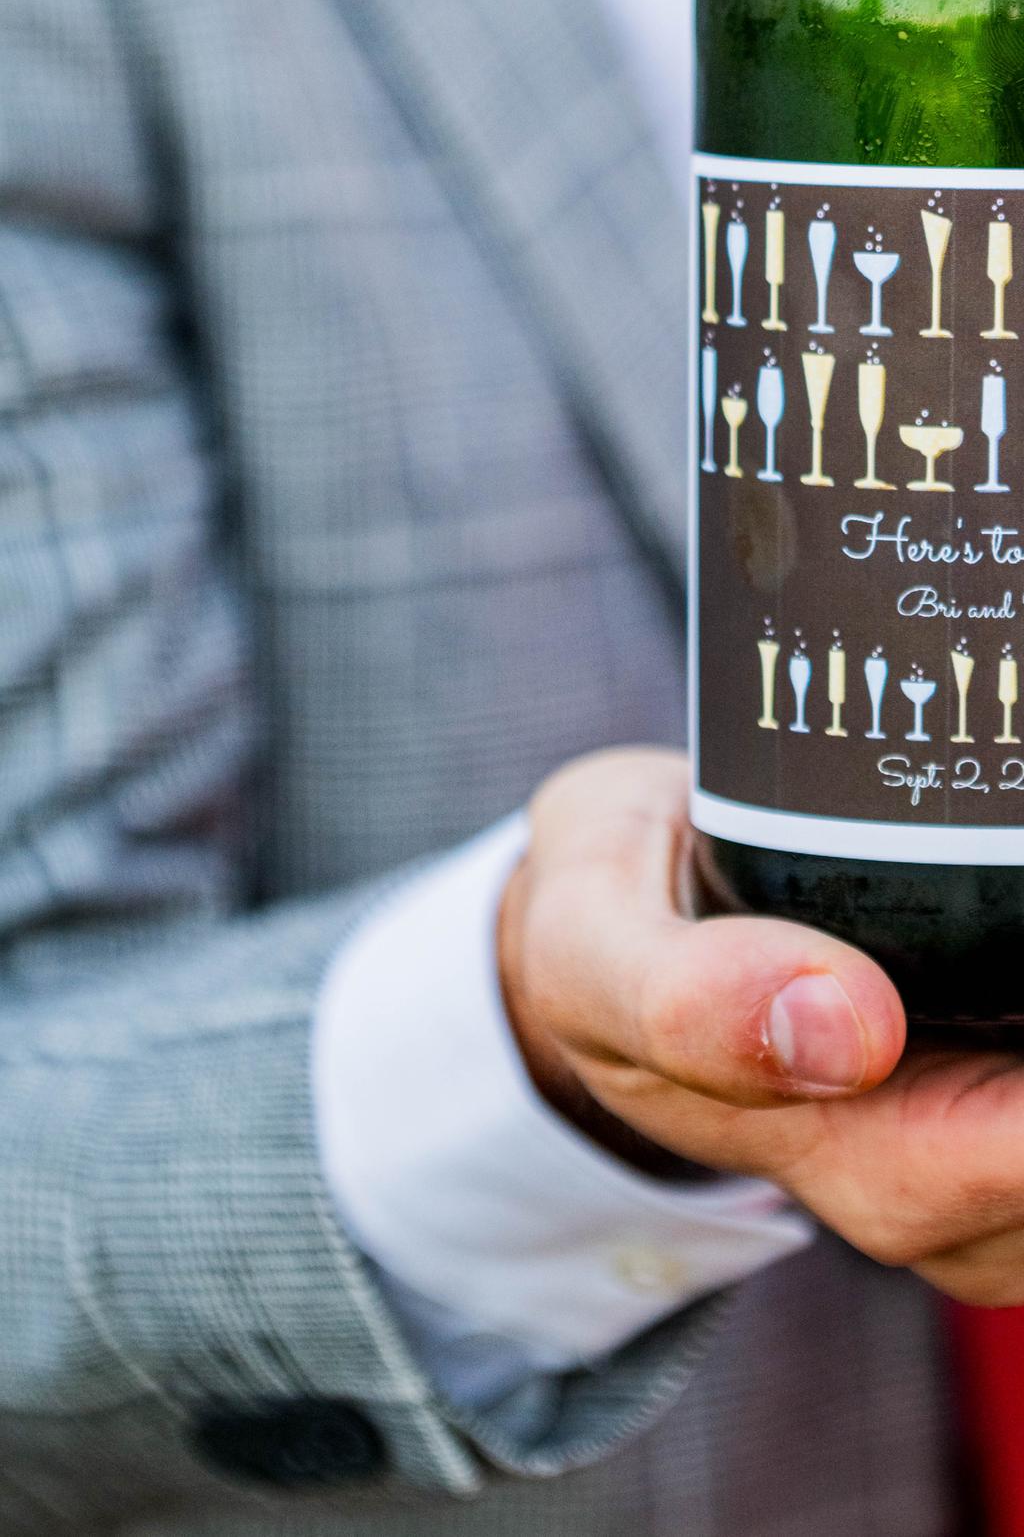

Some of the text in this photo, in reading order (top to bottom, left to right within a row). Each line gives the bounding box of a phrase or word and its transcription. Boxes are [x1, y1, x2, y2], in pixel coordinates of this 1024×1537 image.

[841, 511, 983, 565] Here's
[896, 585, 962, 619] Bri
[968, 591, 1016, 619] and
[876, 755, 945, 807] Sept.
[951, 758, 991, 794] 2,
